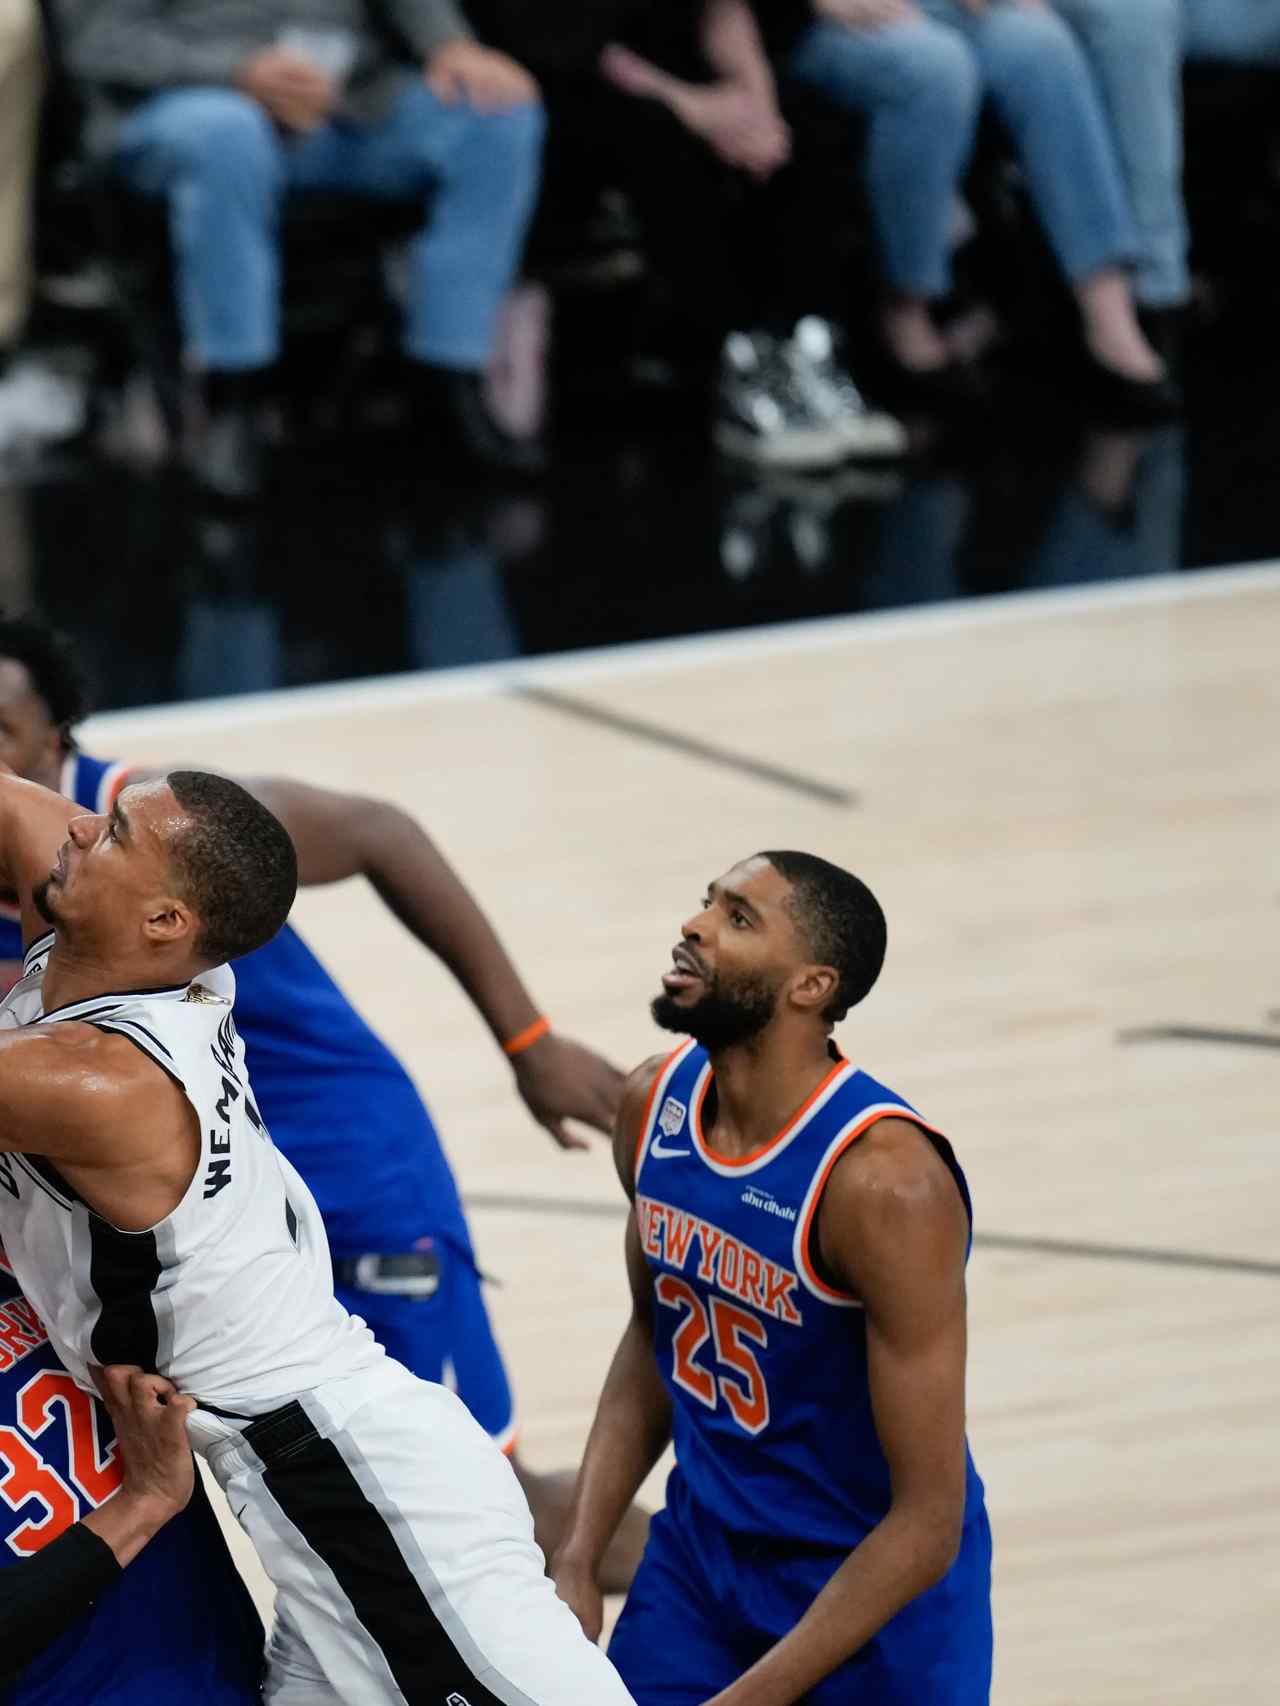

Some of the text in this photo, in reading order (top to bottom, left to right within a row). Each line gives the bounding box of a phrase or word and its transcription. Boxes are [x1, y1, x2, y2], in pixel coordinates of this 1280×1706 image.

[741, 1192, 763, 1209] abu
[763, 1200, 797, 1222] dhabi
[697, 1225, 802, 1327] YORK
[655, 1273, 770, 1435] 25
